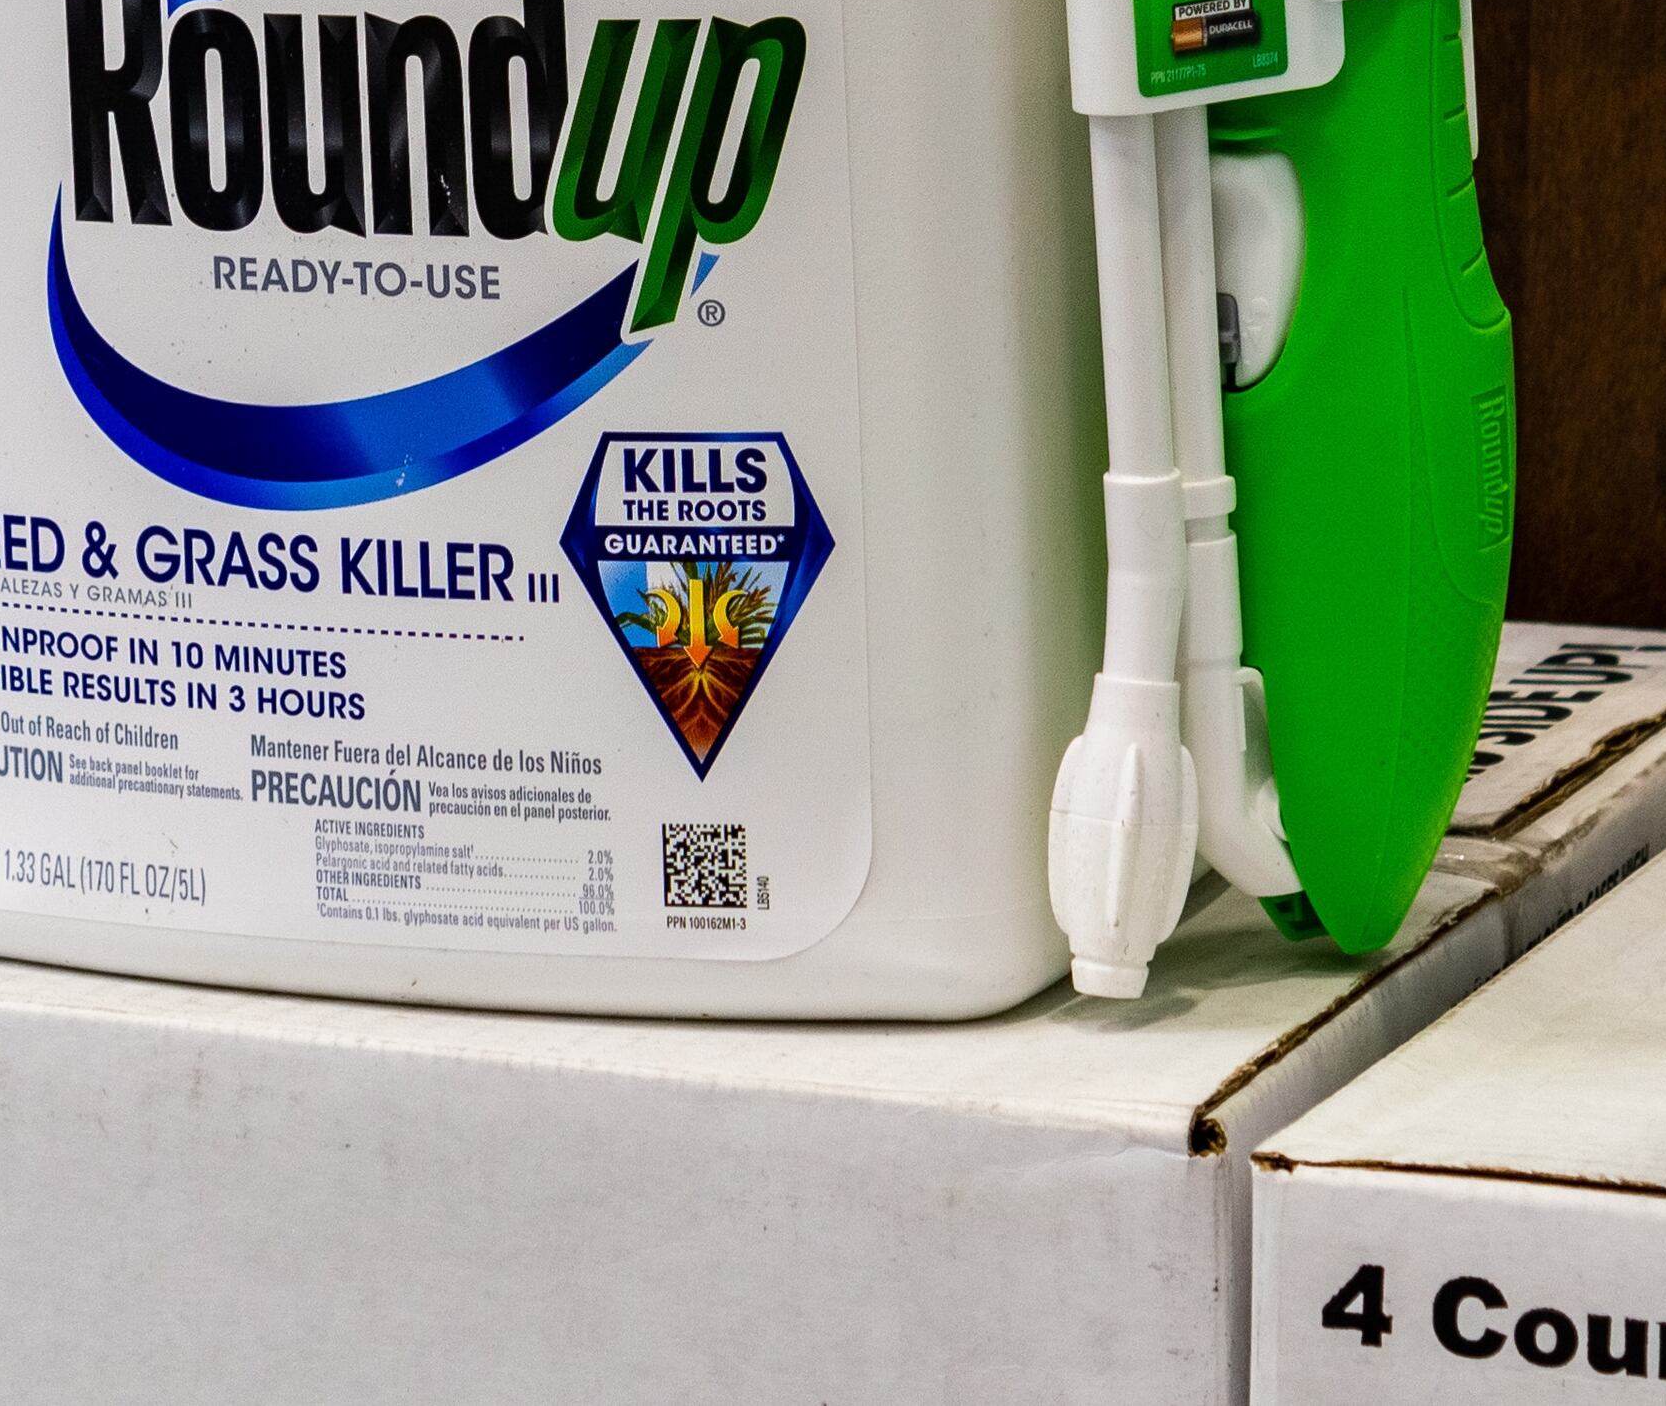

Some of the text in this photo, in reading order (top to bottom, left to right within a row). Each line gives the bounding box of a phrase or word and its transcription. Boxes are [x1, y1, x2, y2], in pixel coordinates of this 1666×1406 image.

[1179, 1, 1230, 17] POWERED
[1209, 19, 1253, 35] DURACELL
[213, 256, 500, 300] READY-TO-USE
[623, 448, 767, 494] KILLS
[623, 500, 767, 521] THE ROOTS
[81, 520, 119, 580] &
[136, 525, 320, 593] GRASS
[340, 537, 514, 602] KILLER
[528, 573, 559, 603] III
[70, 584, 79, 598] Y
[87, 585, 168, 608] GRAMAS
[130, 637, 158, 665] IN
[172, 641, 203, 669] 10
[215, 644, 346, 679] MINUTES
[64, 672, 176, 707] RESULTS
[188, 682, 217, 710] IN
[229, 685, 245, 712] 3
[258, 687, 365, 719] HOURS
[1, 710, 24, 734] Out
[29, 715, 43, 736] of
[46, 716, 91, 742] Reach
[96, 724, 109, 743] of
[115, 724, 178, 750] Children
[69, 754, 199, 780] See back panel booklet for
[251, 734, 602, 775] Mantener Fuera del Alcance de los Niños
[70, 772, 243, 801] additional precautionary statements.
[251, 769, 421, 812] PRECAUCIÓN
[5, 848, 35, 884] 1.33
[41, 852, 75, 888] GAL
[81, 856, 114, 894] (170
[121, 862, 140, 895] FL
[145, 864, 205, 906] OZ/5L)
[667, 916, 746, 930] PPN 100162M1-3
[1322, 1265, 1392, 1347] 4
